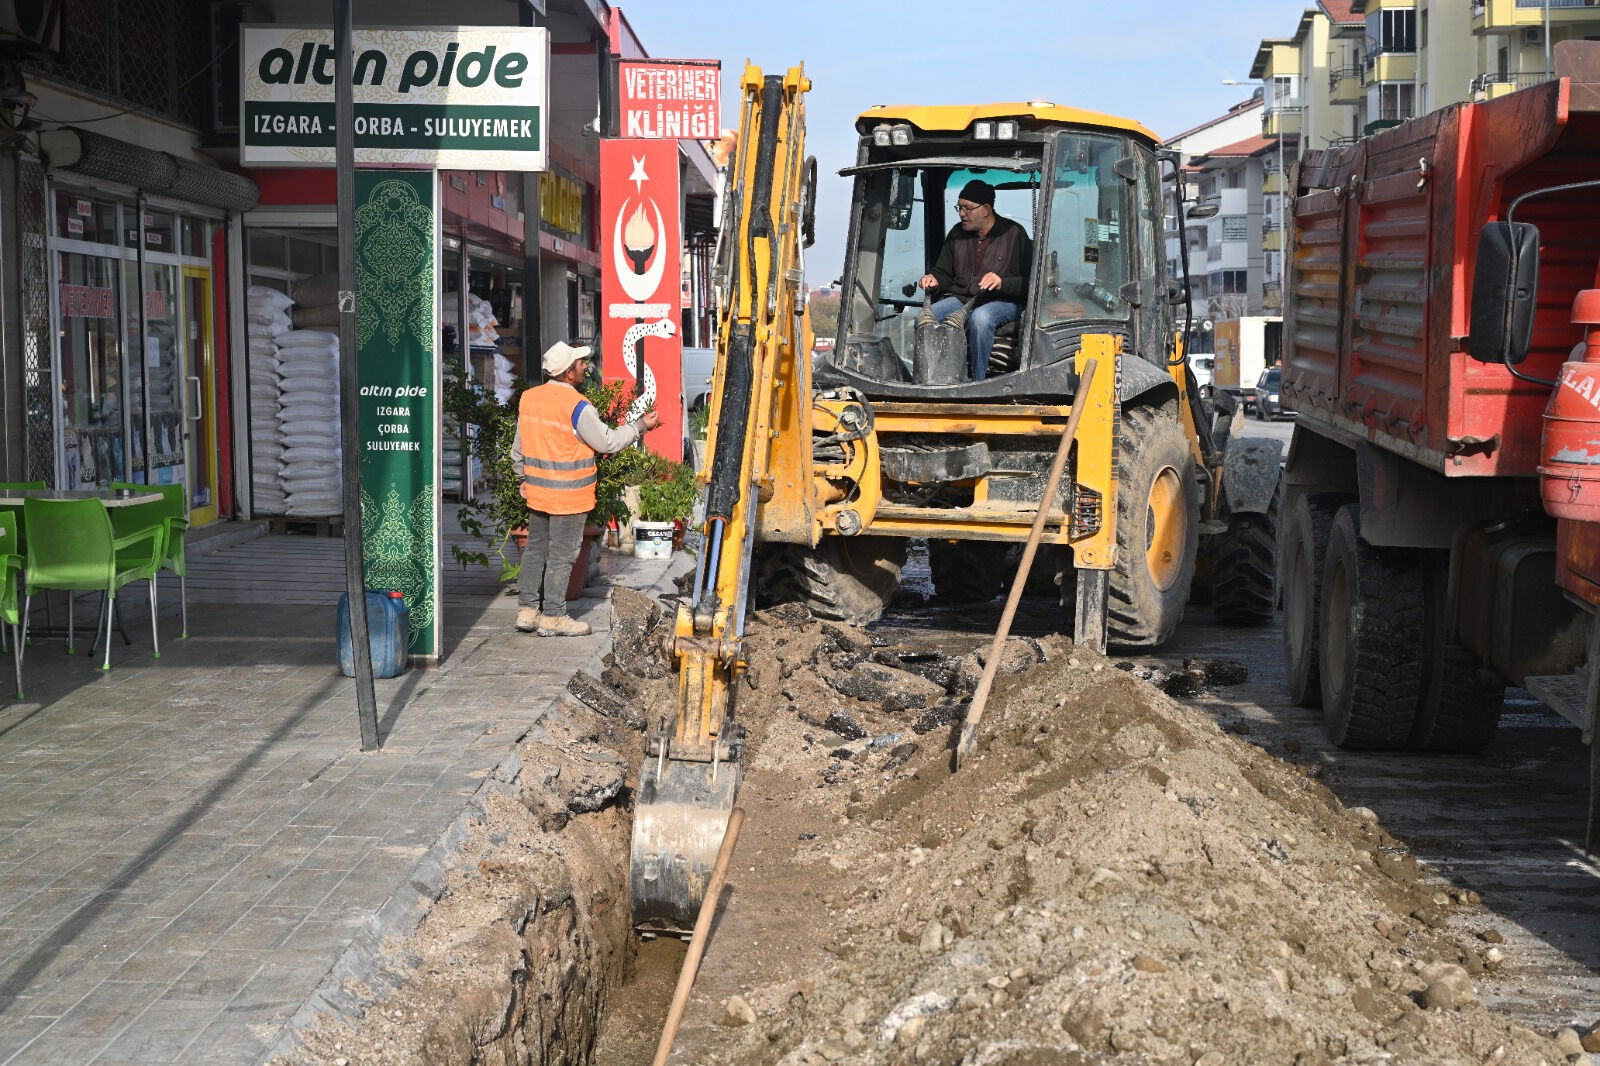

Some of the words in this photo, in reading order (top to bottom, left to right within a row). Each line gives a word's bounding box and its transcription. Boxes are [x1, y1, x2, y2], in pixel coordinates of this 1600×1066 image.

[259, 42, 387, 85] altn
[398, 42, 528, 93] pide
[625, 65, 716, 100] VETERİNER
[254, 115, 322, 134] IZGARA
[354, 117, 404, 136] ORBA
[424, 117, 532, 138] SULUYEMEK
[627, 104, 715, 137] KLİNİĞİ
[394, 385, 427, 398] pide
[376, 406, 411, 416] IZGARA
[377, 424, 409, 436] ÇORBA
[366, 441, 420, 451] SULUYEMEK
